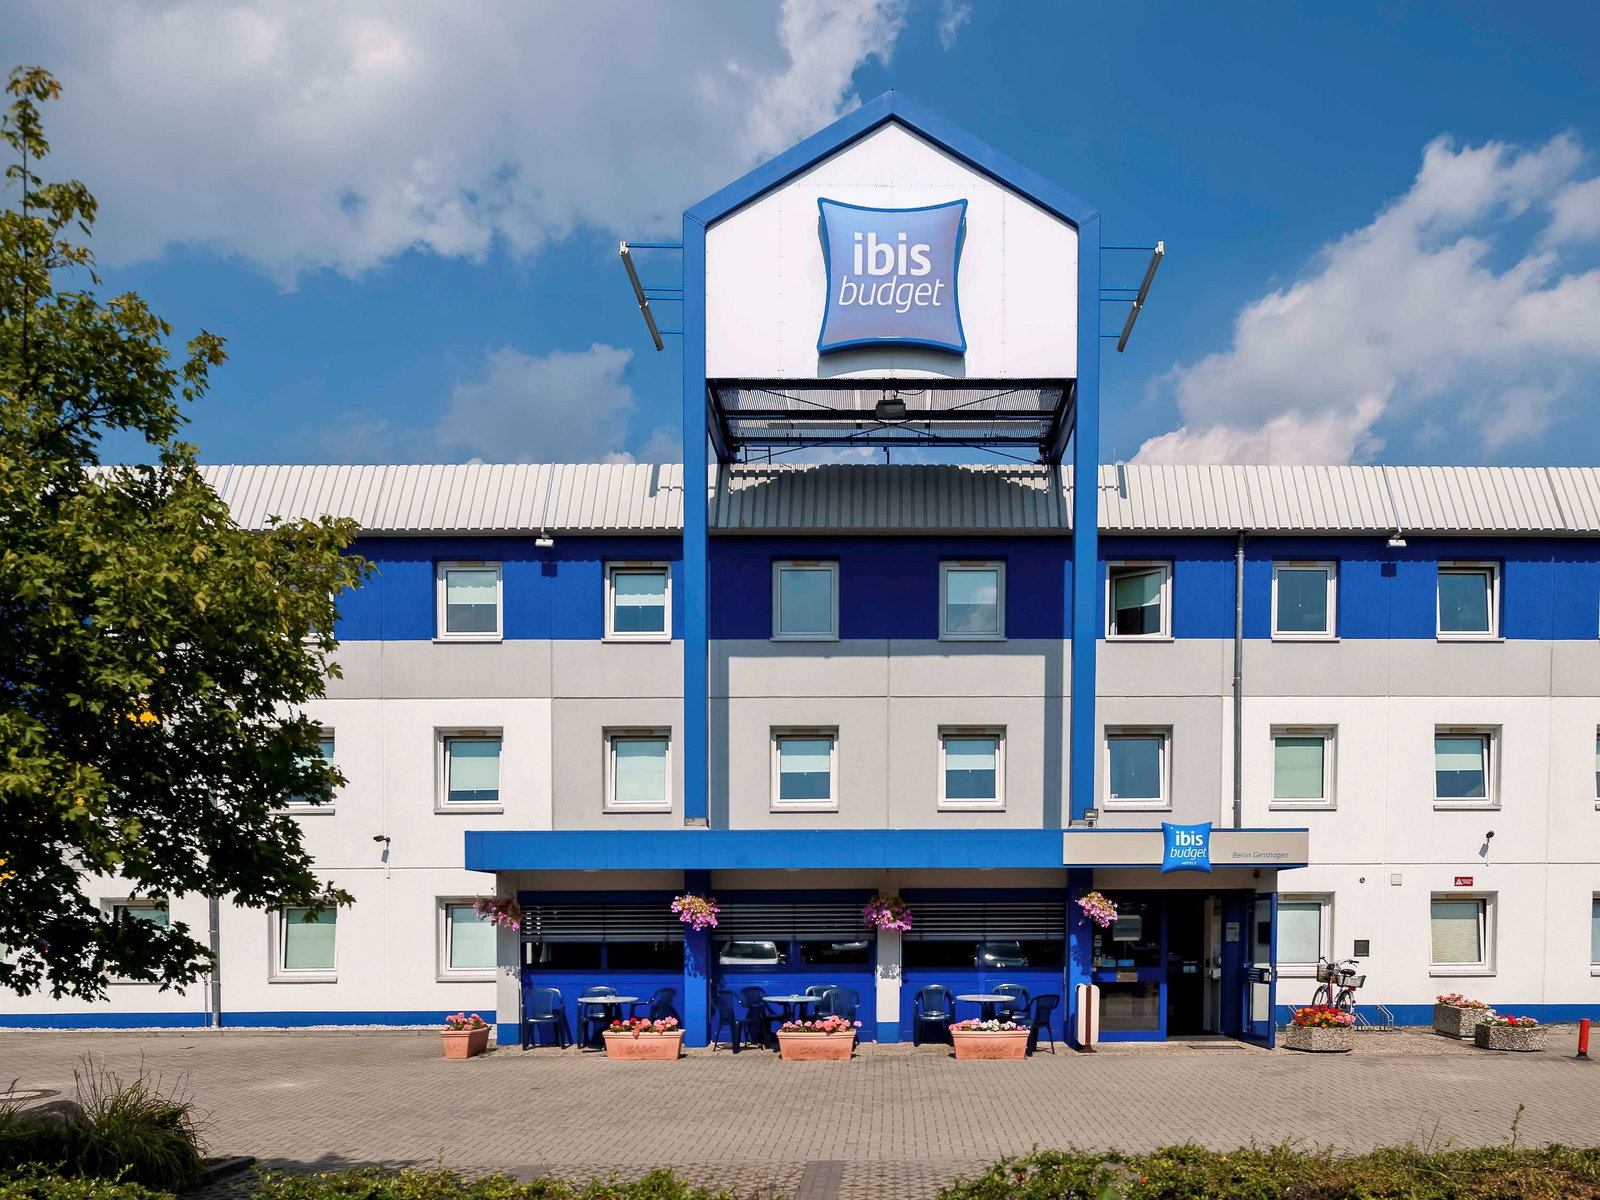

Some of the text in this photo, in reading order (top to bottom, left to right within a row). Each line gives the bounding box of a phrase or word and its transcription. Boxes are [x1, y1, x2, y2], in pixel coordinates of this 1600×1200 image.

[853, 232, 932, 276] ibis
[838, 275, 944, 314] budget
[1175, 830, 1204, 846] ibis
[1170, 846, 1207, 860] budget
[1232, 851, 1289, 860] Berlin Genshagen
